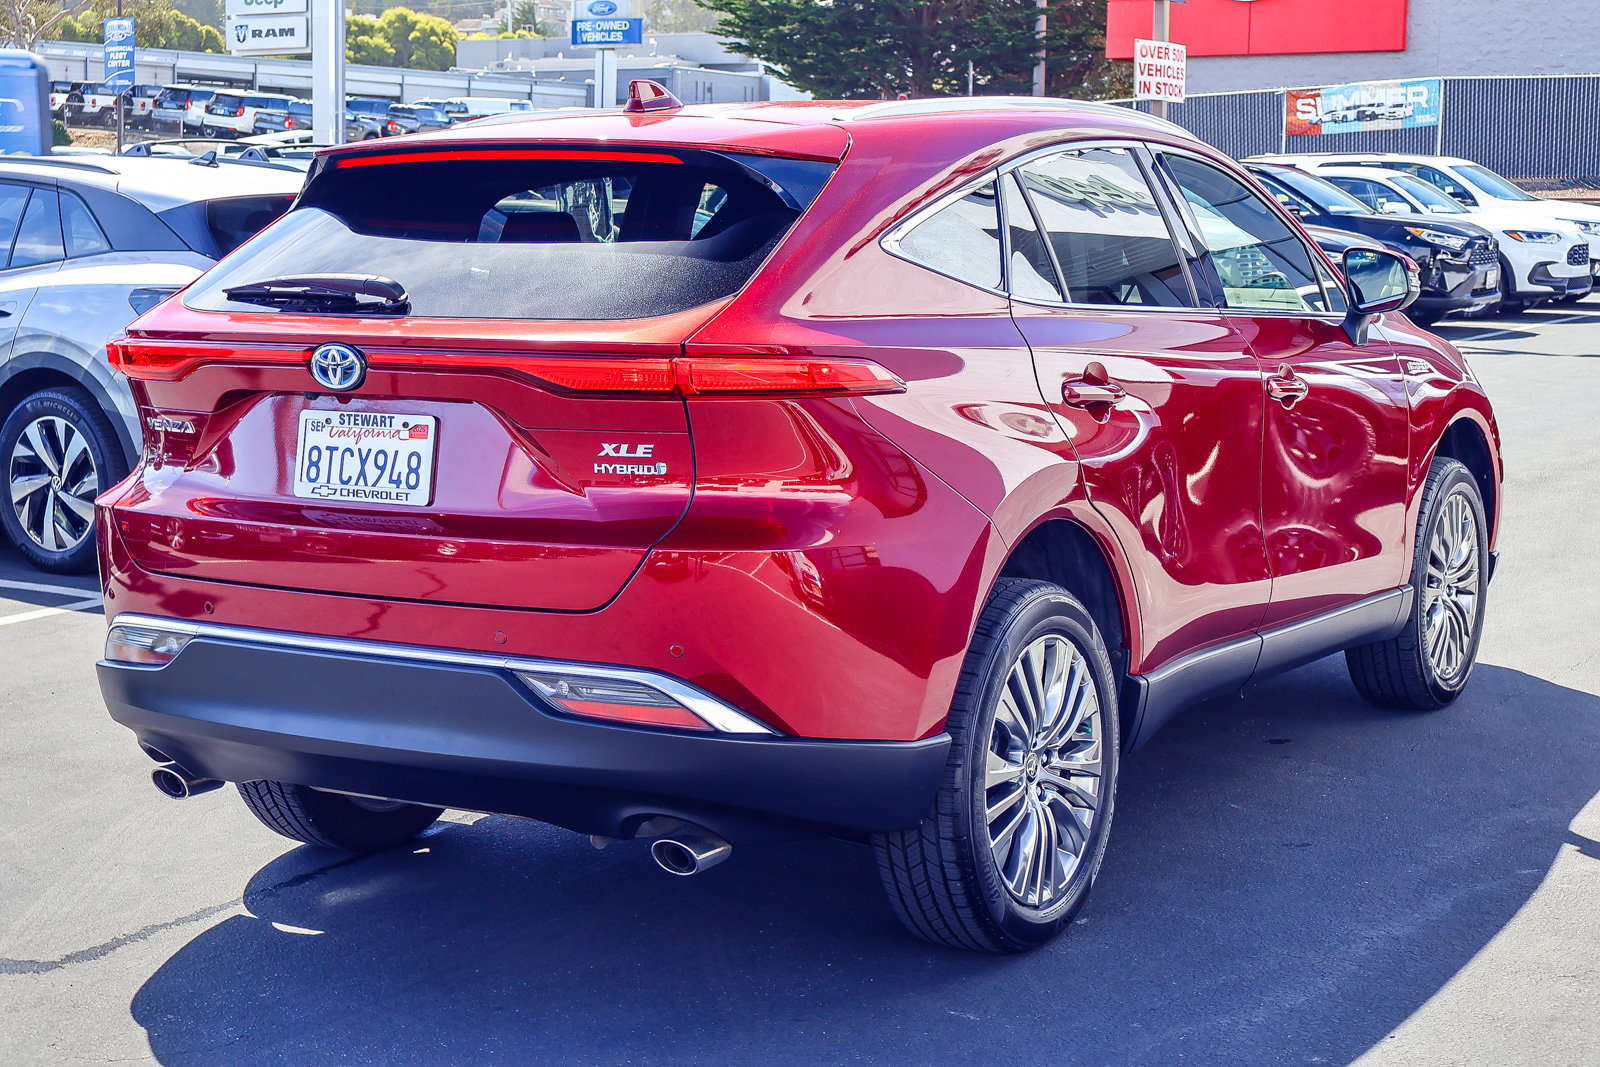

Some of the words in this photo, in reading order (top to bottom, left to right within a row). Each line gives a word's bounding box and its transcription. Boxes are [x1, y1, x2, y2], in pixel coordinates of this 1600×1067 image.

[251, 27, 295, 39] RAM
[576, 20, 630, 31] PRE-OWNED
[581, 31, 624, 42] VEHICLES
[109, 52, 128, 60] FLEET
[1140, 44, 1170, 60] OVER
[1172, 48, 1185, 63] 500
[107, 60, 131, 68] CENTER
[1138, 62, 1185, 81] VEHICLES
[1138, 80, 1151, 94] IN
[1155, 81, 1184, 98] STOCK
[1295, 85, 1429, 122] SUMMER
[43, 401, 79, 422] MICHELIN
[147, 415, 196, 434] VENZA
[310, 420, 326, 432] SEP
[338, 412, 395, 428] STEWART
[329, 426, 409, 445] California
[597, 443, 655, 458] XLE
[306, 445, 422, 490] 8TCX948
[593, 463, 655, 476] HYBRID
[339, 487, 411, 501] CHEVROLET
